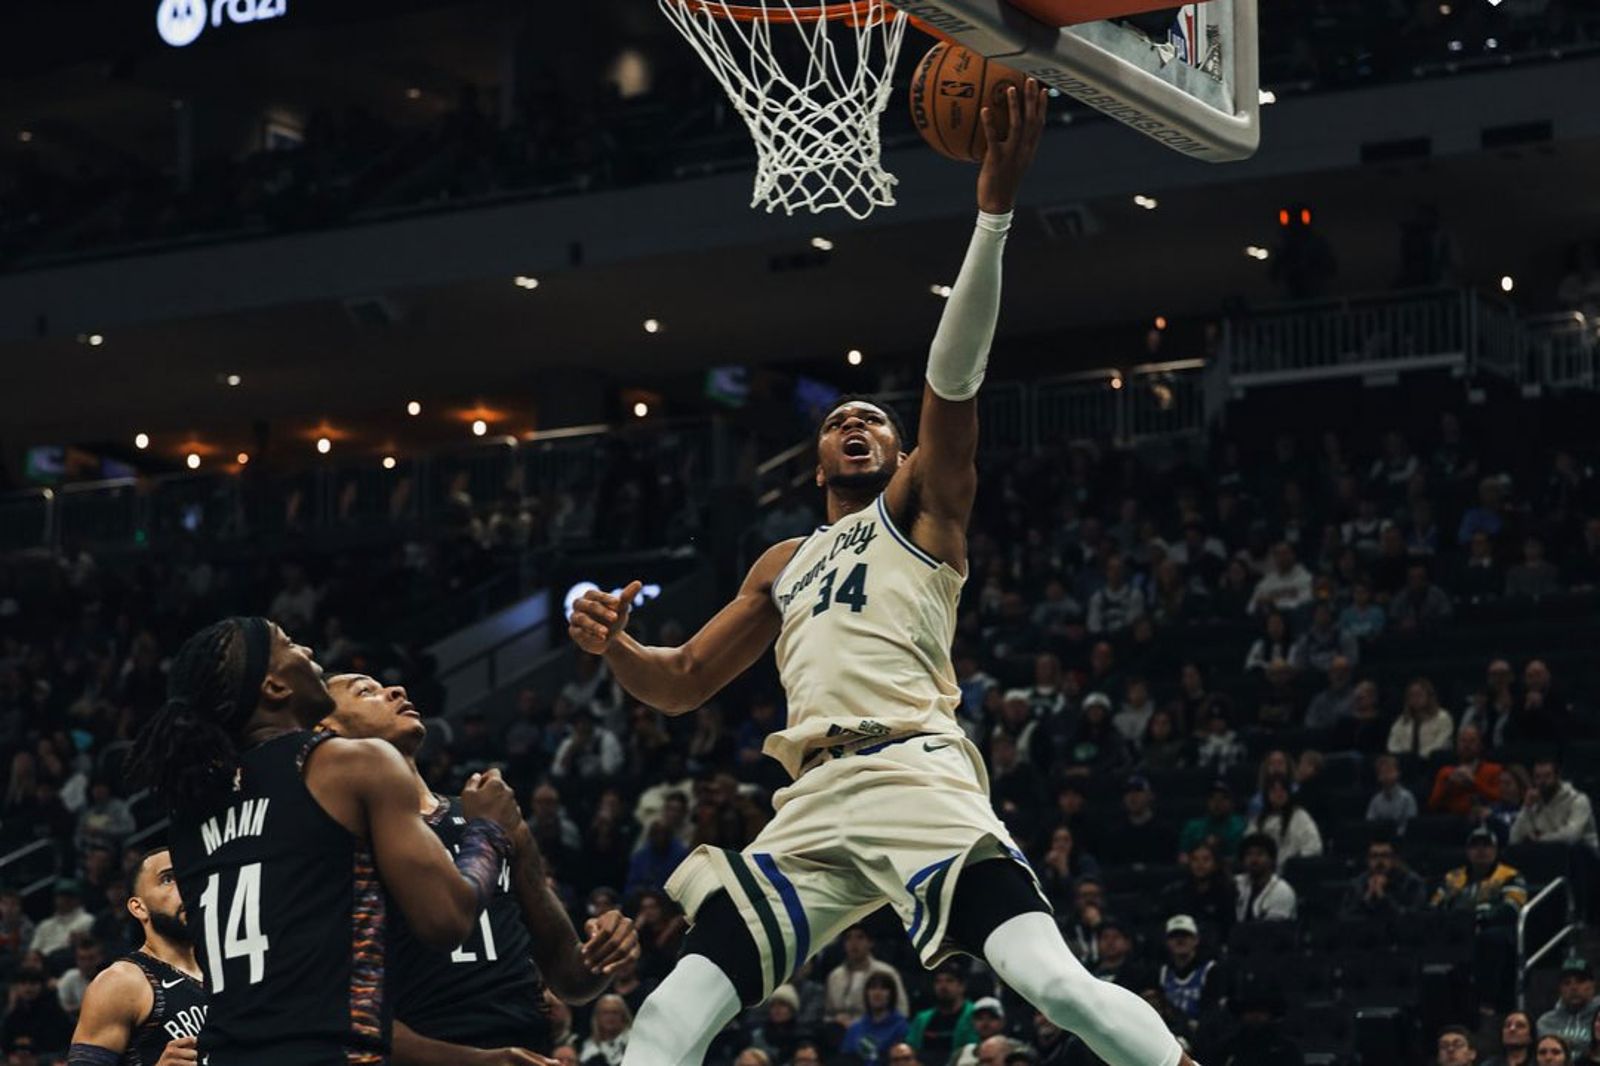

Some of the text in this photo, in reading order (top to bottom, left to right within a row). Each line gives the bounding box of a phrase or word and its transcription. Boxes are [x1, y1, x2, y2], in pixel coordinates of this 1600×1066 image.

[829, 521, 878, 560] City
[812, 562, 868, 617] 34
[201, 797, 271, 856] MANN
[199, 862, 270, 994] 14
